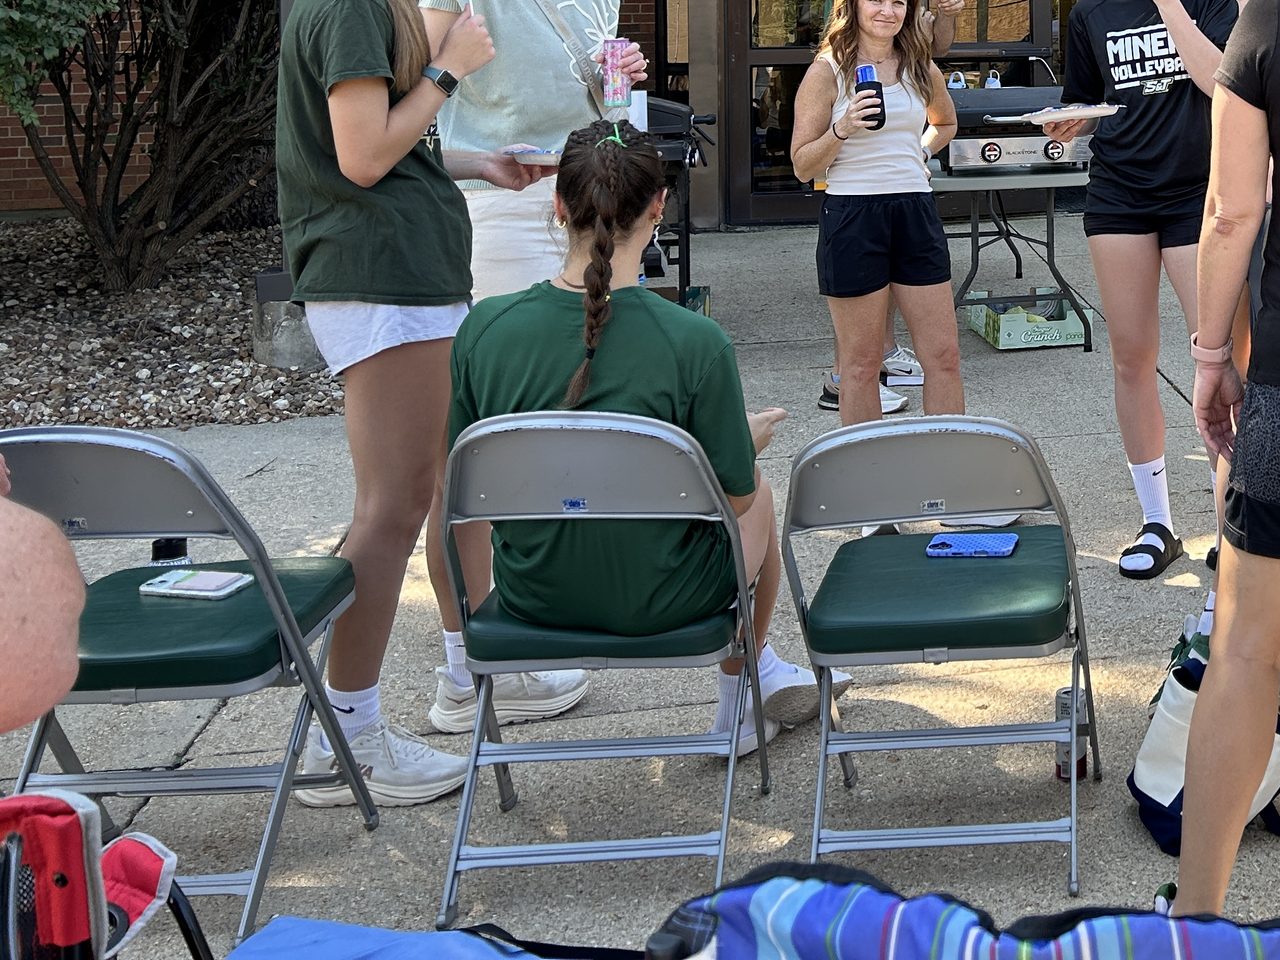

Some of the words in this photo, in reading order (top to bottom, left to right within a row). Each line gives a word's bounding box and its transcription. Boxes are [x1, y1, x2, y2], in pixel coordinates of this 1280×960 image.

[1106, 31, 1175, 65] MINE
[1110, 56, 1186, 82] VOLLEYBA
[1141, 77, 1174, 95] S&T
[1021, 329, 1061, 343] Crunch
